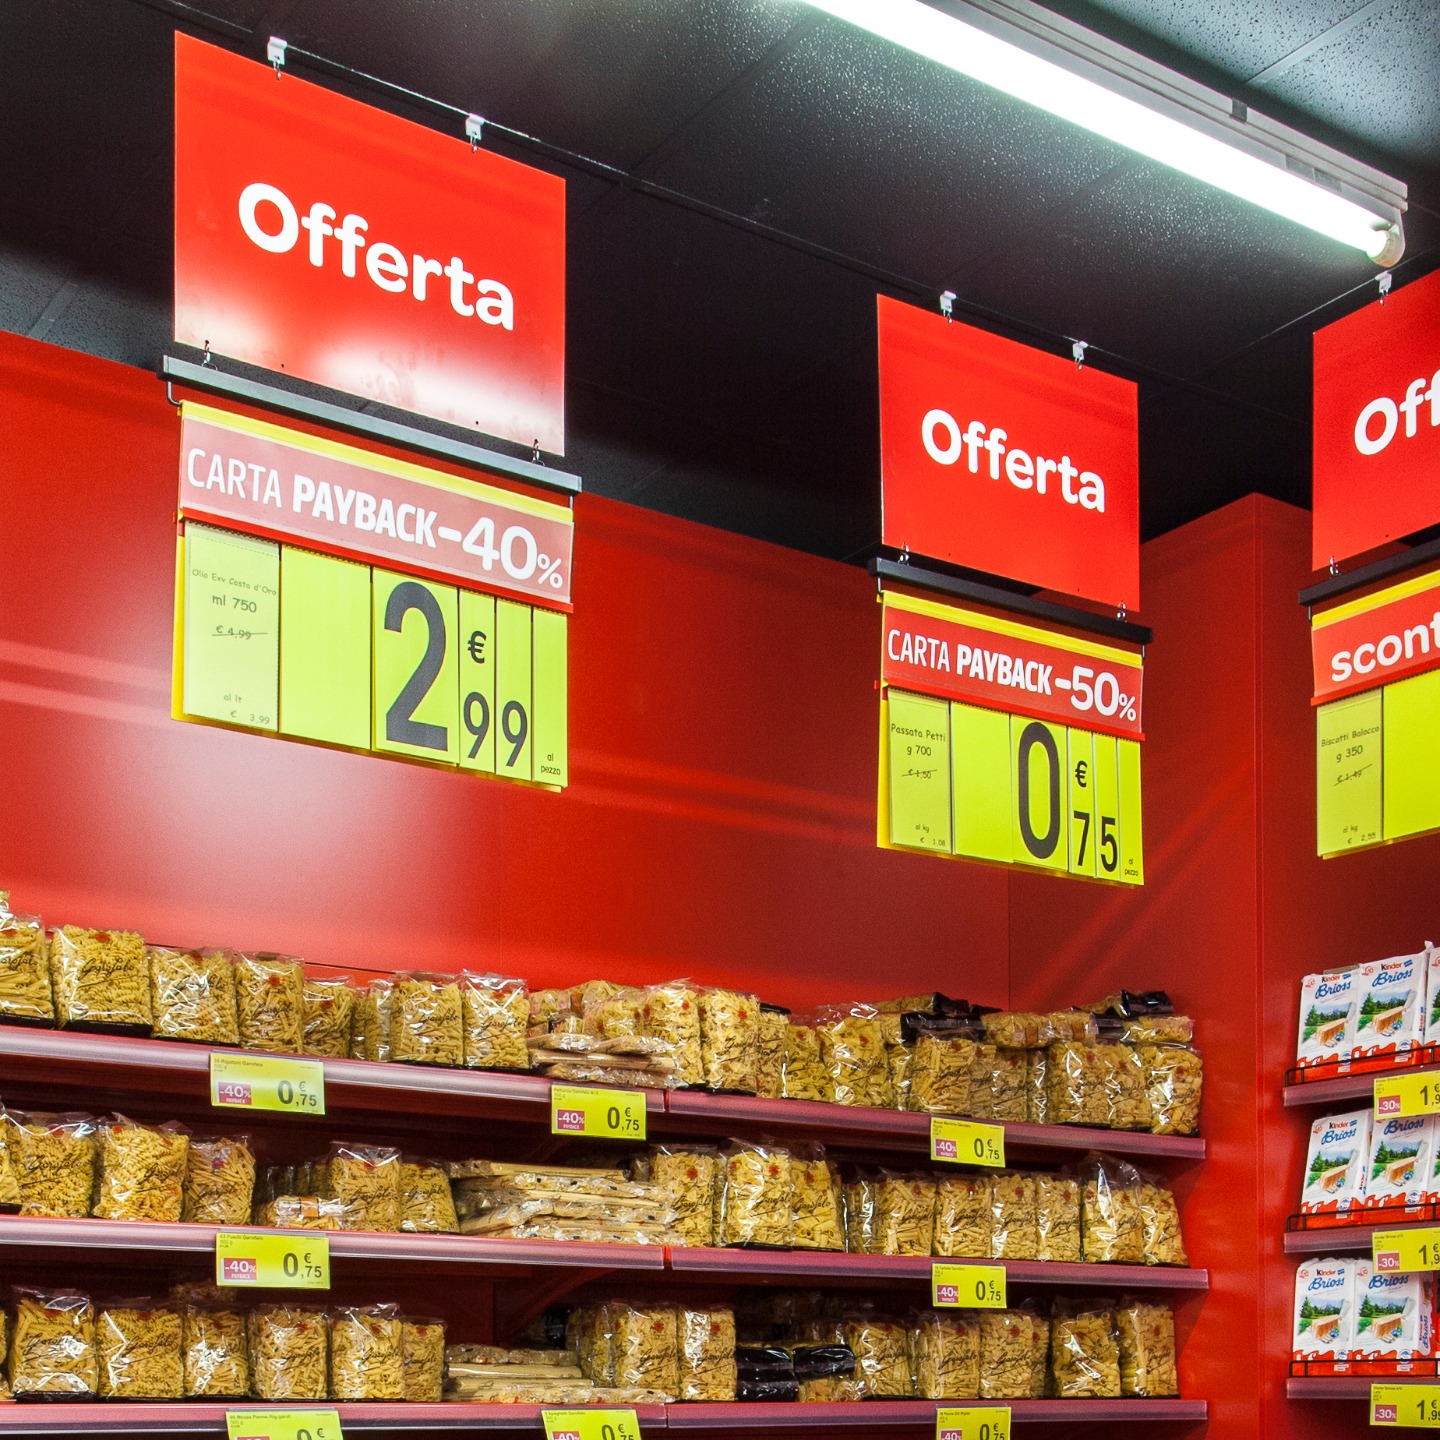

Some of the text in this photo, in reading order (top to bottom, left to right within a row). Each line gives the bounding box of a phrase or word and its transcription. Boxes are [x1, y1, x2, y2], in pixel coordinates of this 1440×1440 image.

[238, 182, 514, 331] Offerta
[921, 409, 1105, 513] Offerta
[187, 447, 282, 508] CARTA
[293, 473, 438, 547] PAYBACK
[192, 568, 209, 580] Olio
[228, 576, 252, 589] Costa
[253, 581, 277, 597] d'Oro
[212, 593, 257, 614] ml 750
[384, 581, 448, 751] 2
[888, 629, 950, 672] CARTA
[956, 643, 1053, 696] PAYBACK
[891, 723, 946, 742] Passata Petti
[1321, 725, 1380, 748] Biscotti Balocco
[547, 752, 554, 763] al
[907, 745, 932, 757] g 700
[1336, 745, 1364, 763] g 350
[540, 764, 561, 777] pezzo
[1018, 721, 1061, 859] 0
